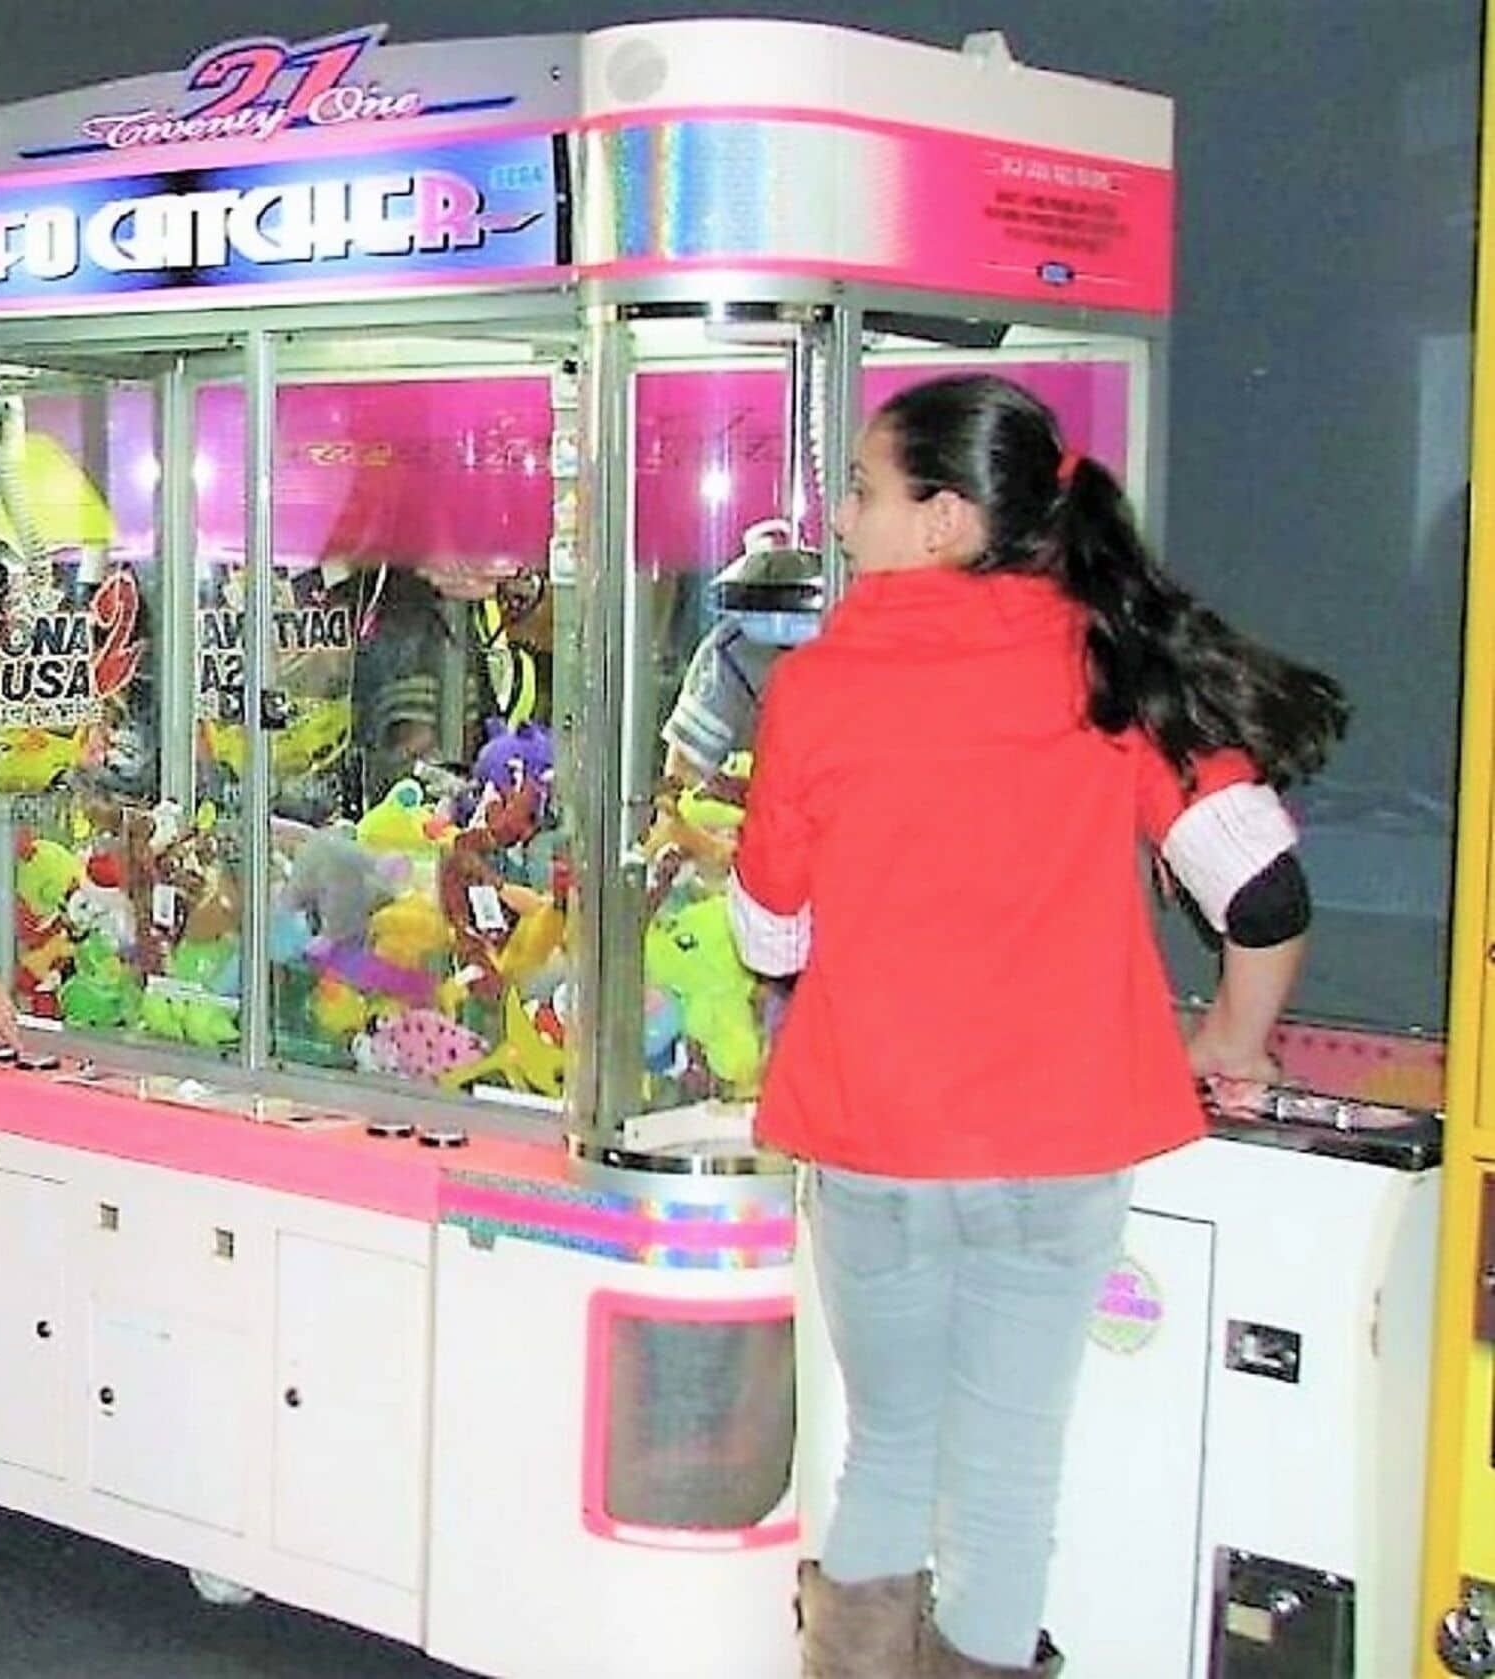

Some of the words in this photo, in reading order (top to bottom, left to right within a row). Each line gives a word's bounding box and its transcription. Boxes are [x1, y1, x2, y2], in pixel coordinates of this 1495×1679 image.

[81, 108, 288, 149] Twenty
[306, 84, 420, 125] One
[187, 33, 372, 130] 21
[85, 170, 485, 273] CATCHER
[2, 658, 92, 701] USA
